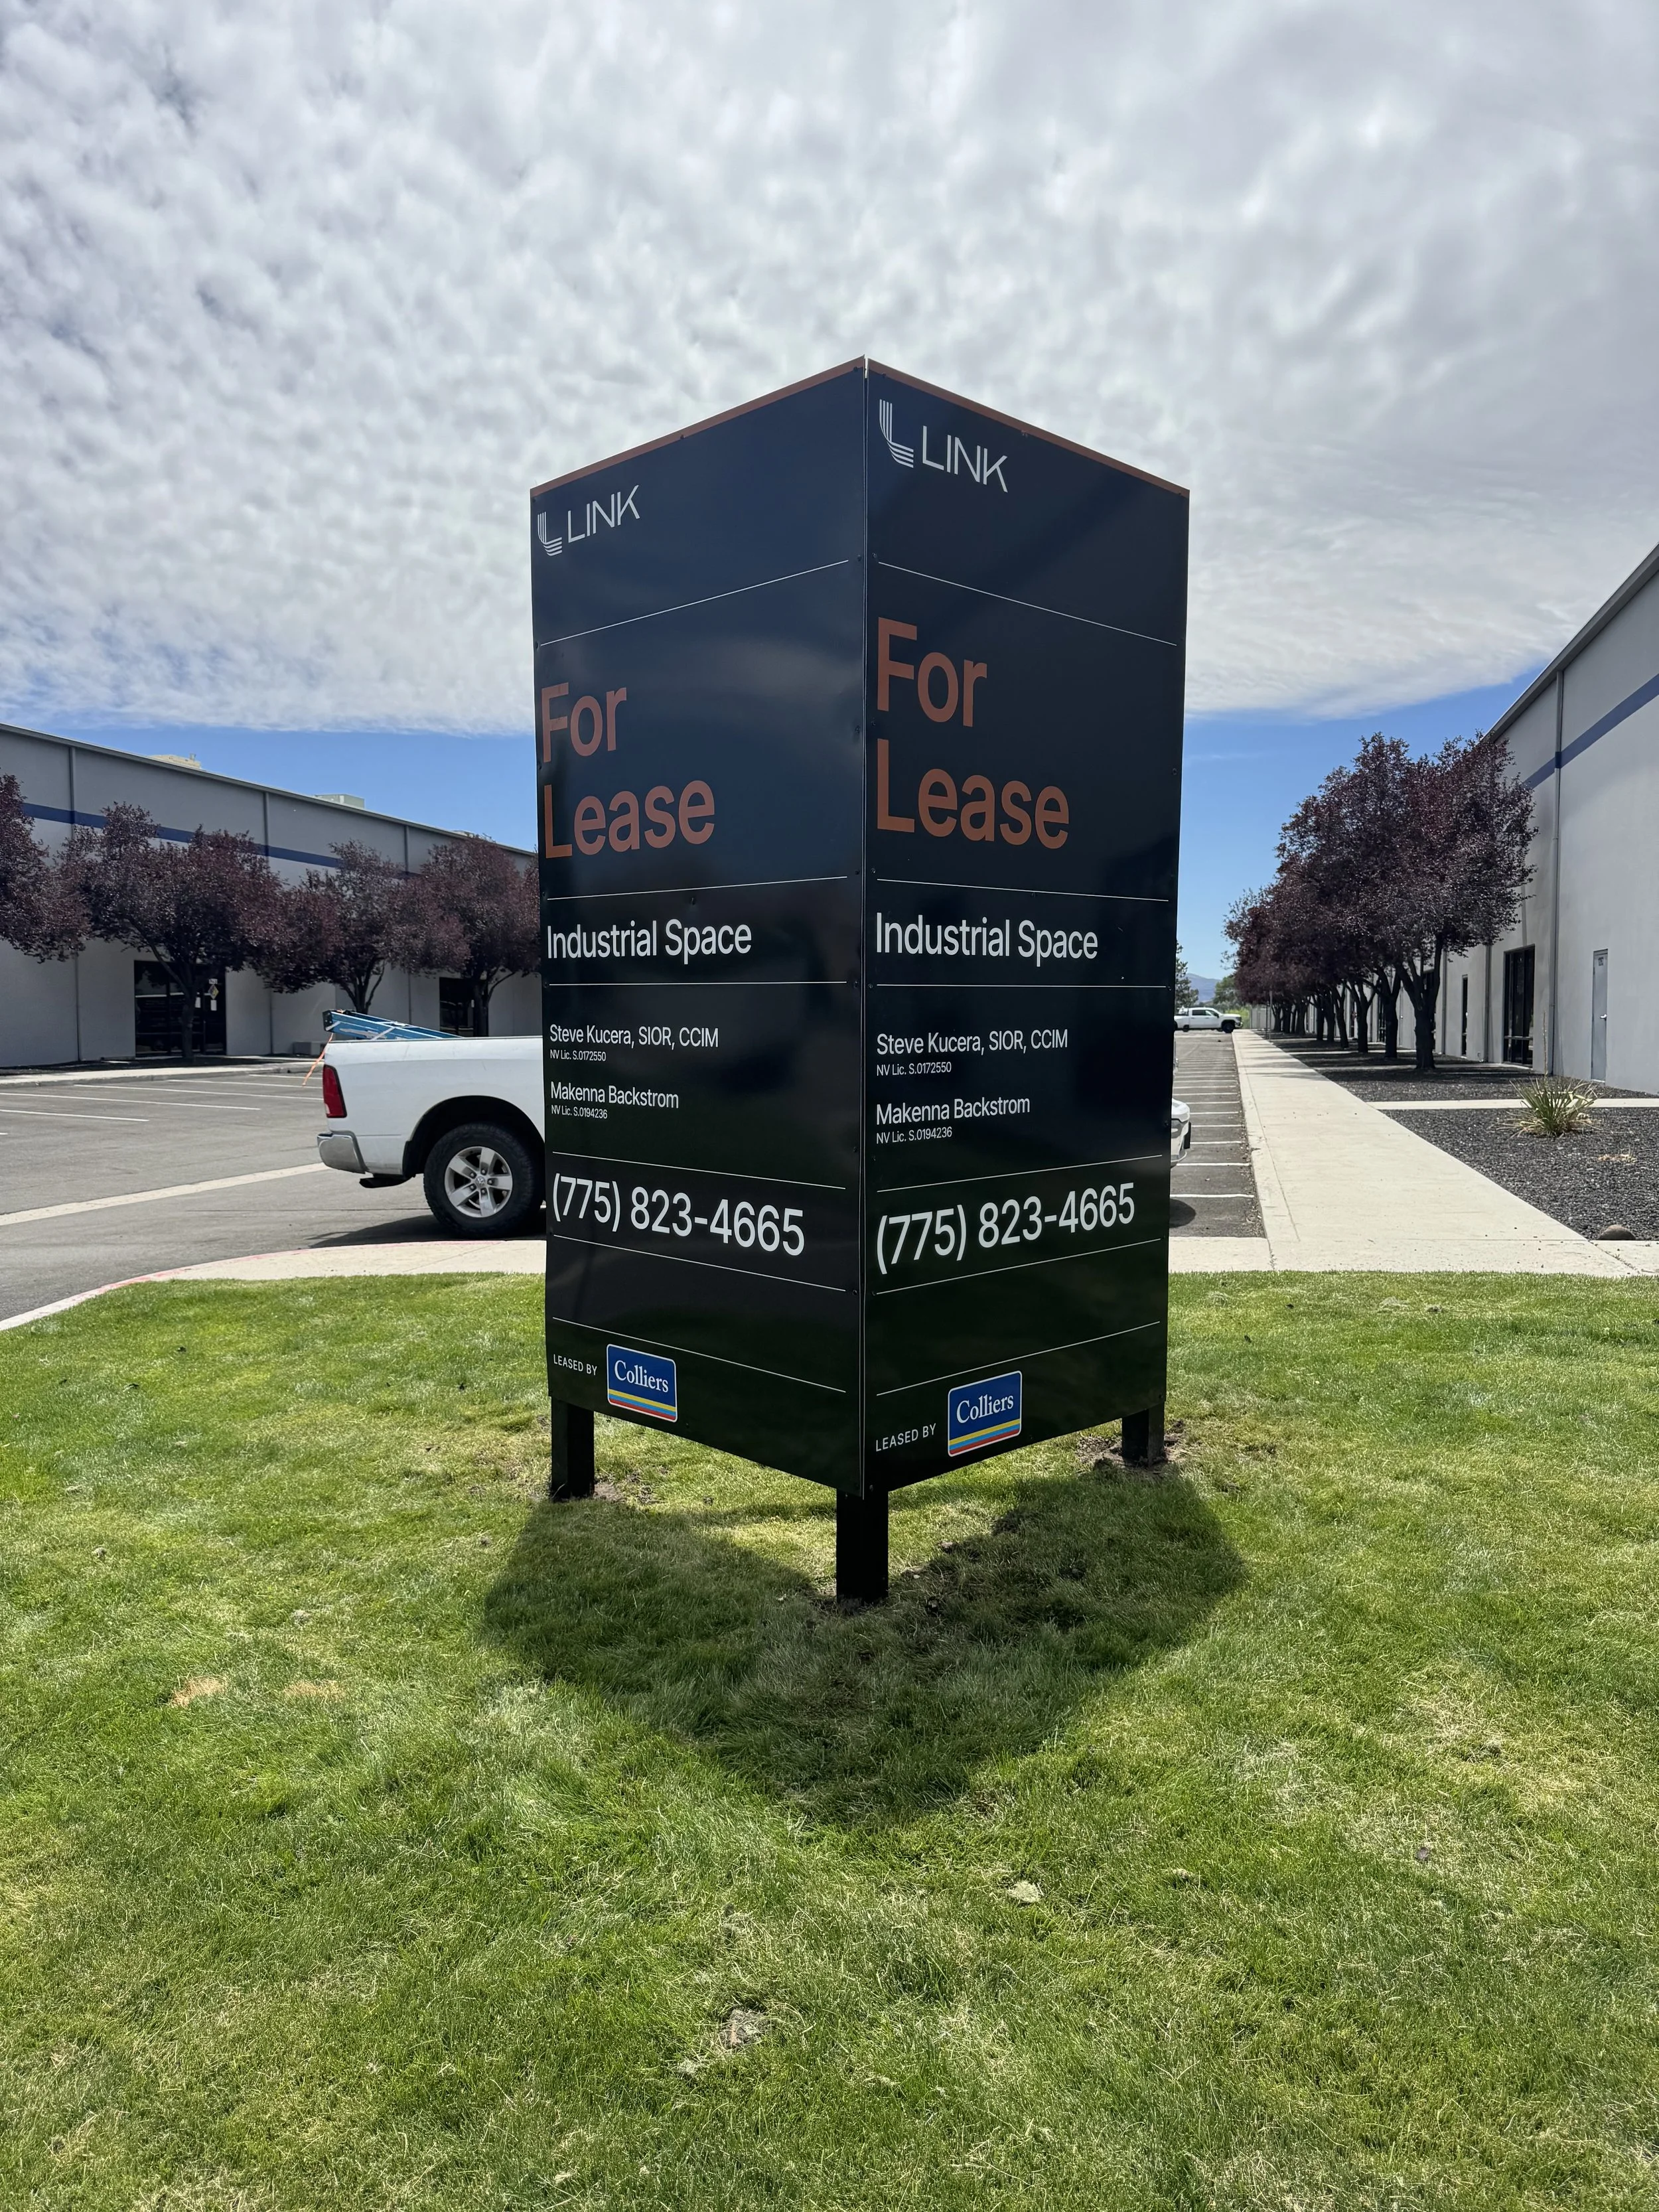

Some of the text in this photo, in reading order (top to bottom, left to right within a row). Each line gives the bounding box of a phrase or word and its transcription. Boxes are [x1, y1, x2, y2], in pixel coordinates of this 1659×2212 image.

[922, 425, 1008, 493] LINK
[567, 484, 640, 544] LINK
[877, 617, 987, 727] For
[541, 682, 627, 763] For
[877, 738, 1069, 849] Lease
[544, 780, 715, 859] Lease
[547, 919, 752, 965] Industrial Space
[877, 912, 1098, 968] Industrial Space
[549, 1023, 719, 1051] Steve Kucera, SIOR, CCIM
[877, 1029, 1068, 1056] Steve Kucera, SIOR, CCIM
[549, 1049, 607, 1062] NV Lic. S.0172550
[877, 1061, 952, 1076] NV Lic. S.0172550
[551, 1081, 679, 1109] Makenna Backstrom
[876, 1096, 1030, 1126] Makenna Backstrom
[551, 1104, 608, 1120] NV Lic. S.0194236
[876, 1126, 952, 1144] NV Lic. S.0194236
[553, 1173, 805, 1256] (775) 823-4665
[877, 1182, 1135, 1275] (775) 823-4665
[553, 1354, 597, 1376] LEASED BY
[614, 1359, 669, 1393] Colliers
[956, 1394, 1014, 1424] Colliers
[875, 1422, 936, 1452] LEASED BY
